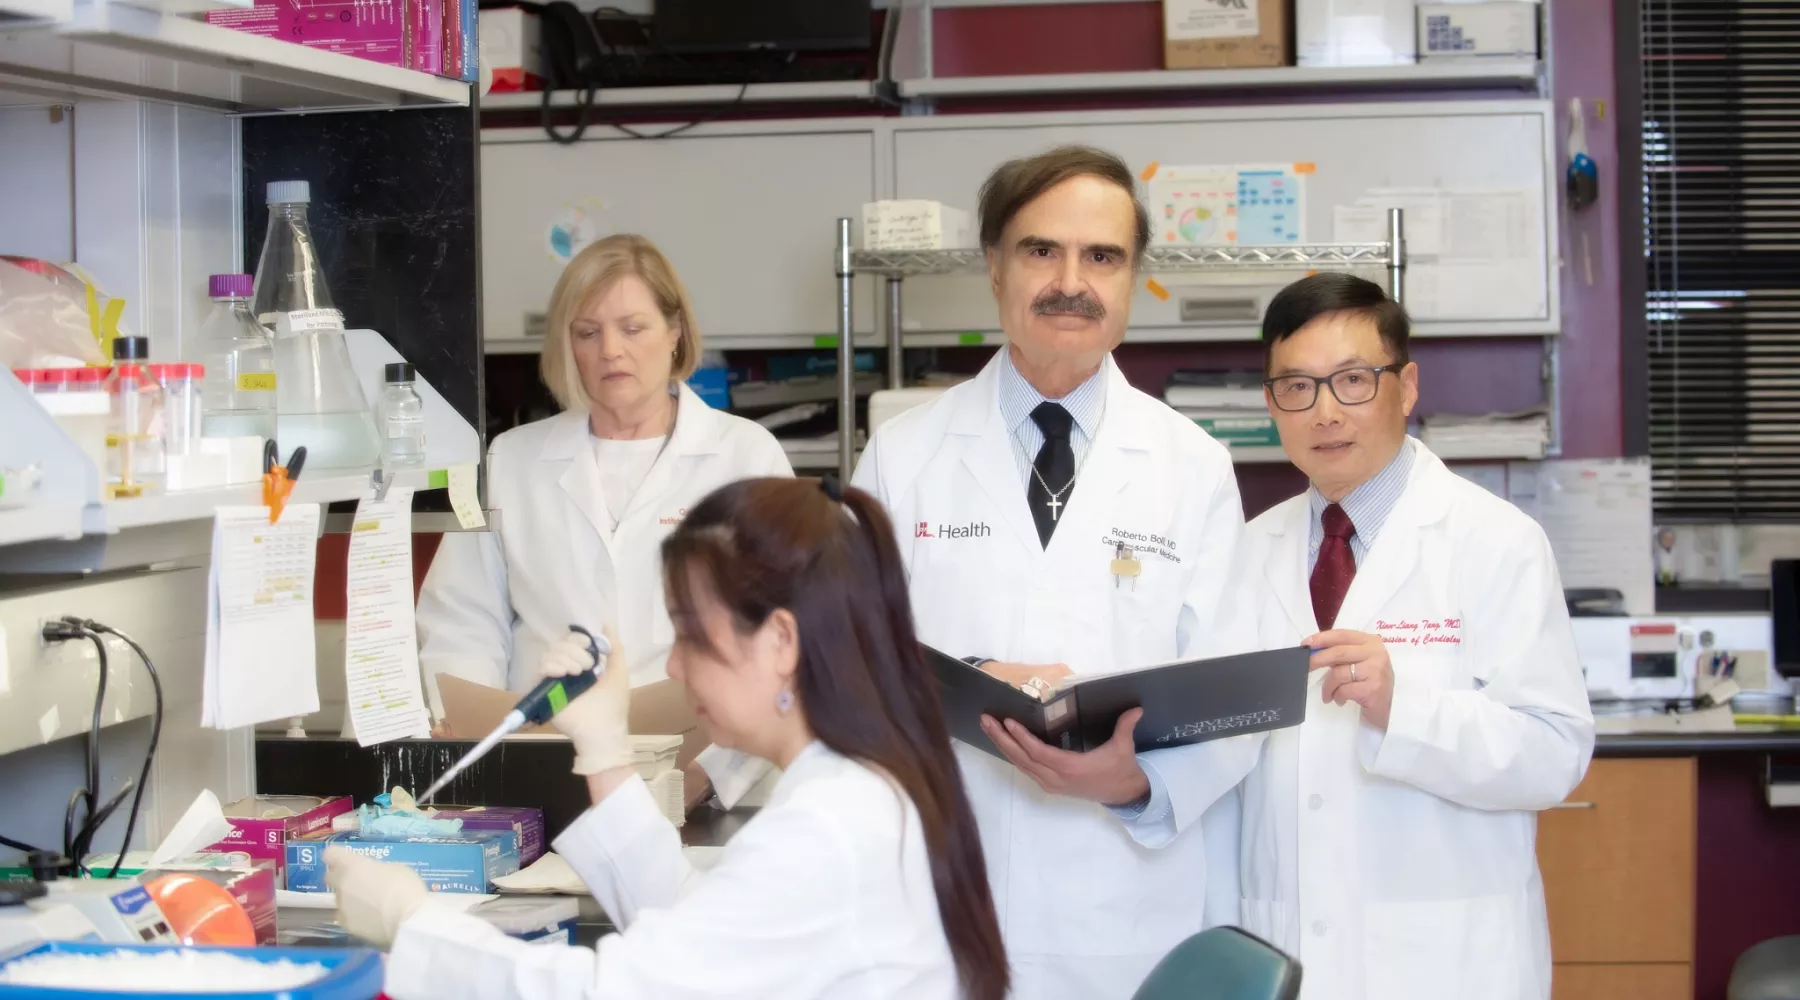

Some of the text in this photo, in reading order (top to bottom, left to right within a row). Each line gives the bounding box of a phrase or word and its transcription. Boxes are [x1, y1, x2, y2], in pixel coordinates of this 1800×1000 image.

[938, 521, 991, 539] Health
[1111, 527, 1148, 542] Roberto
[1101, 536, 1182, 564] Cardscular Medicine
[1410, 635, 1421, 646] of
[1156, 713, 1281, 743] of LOUISVILLE
[1173, 707, 1284, 733] UNIVERSITY
[267, 831, 278, 843] S
[300, 848, 314, 863] S
[345, 844, 391, 860] Protégé
